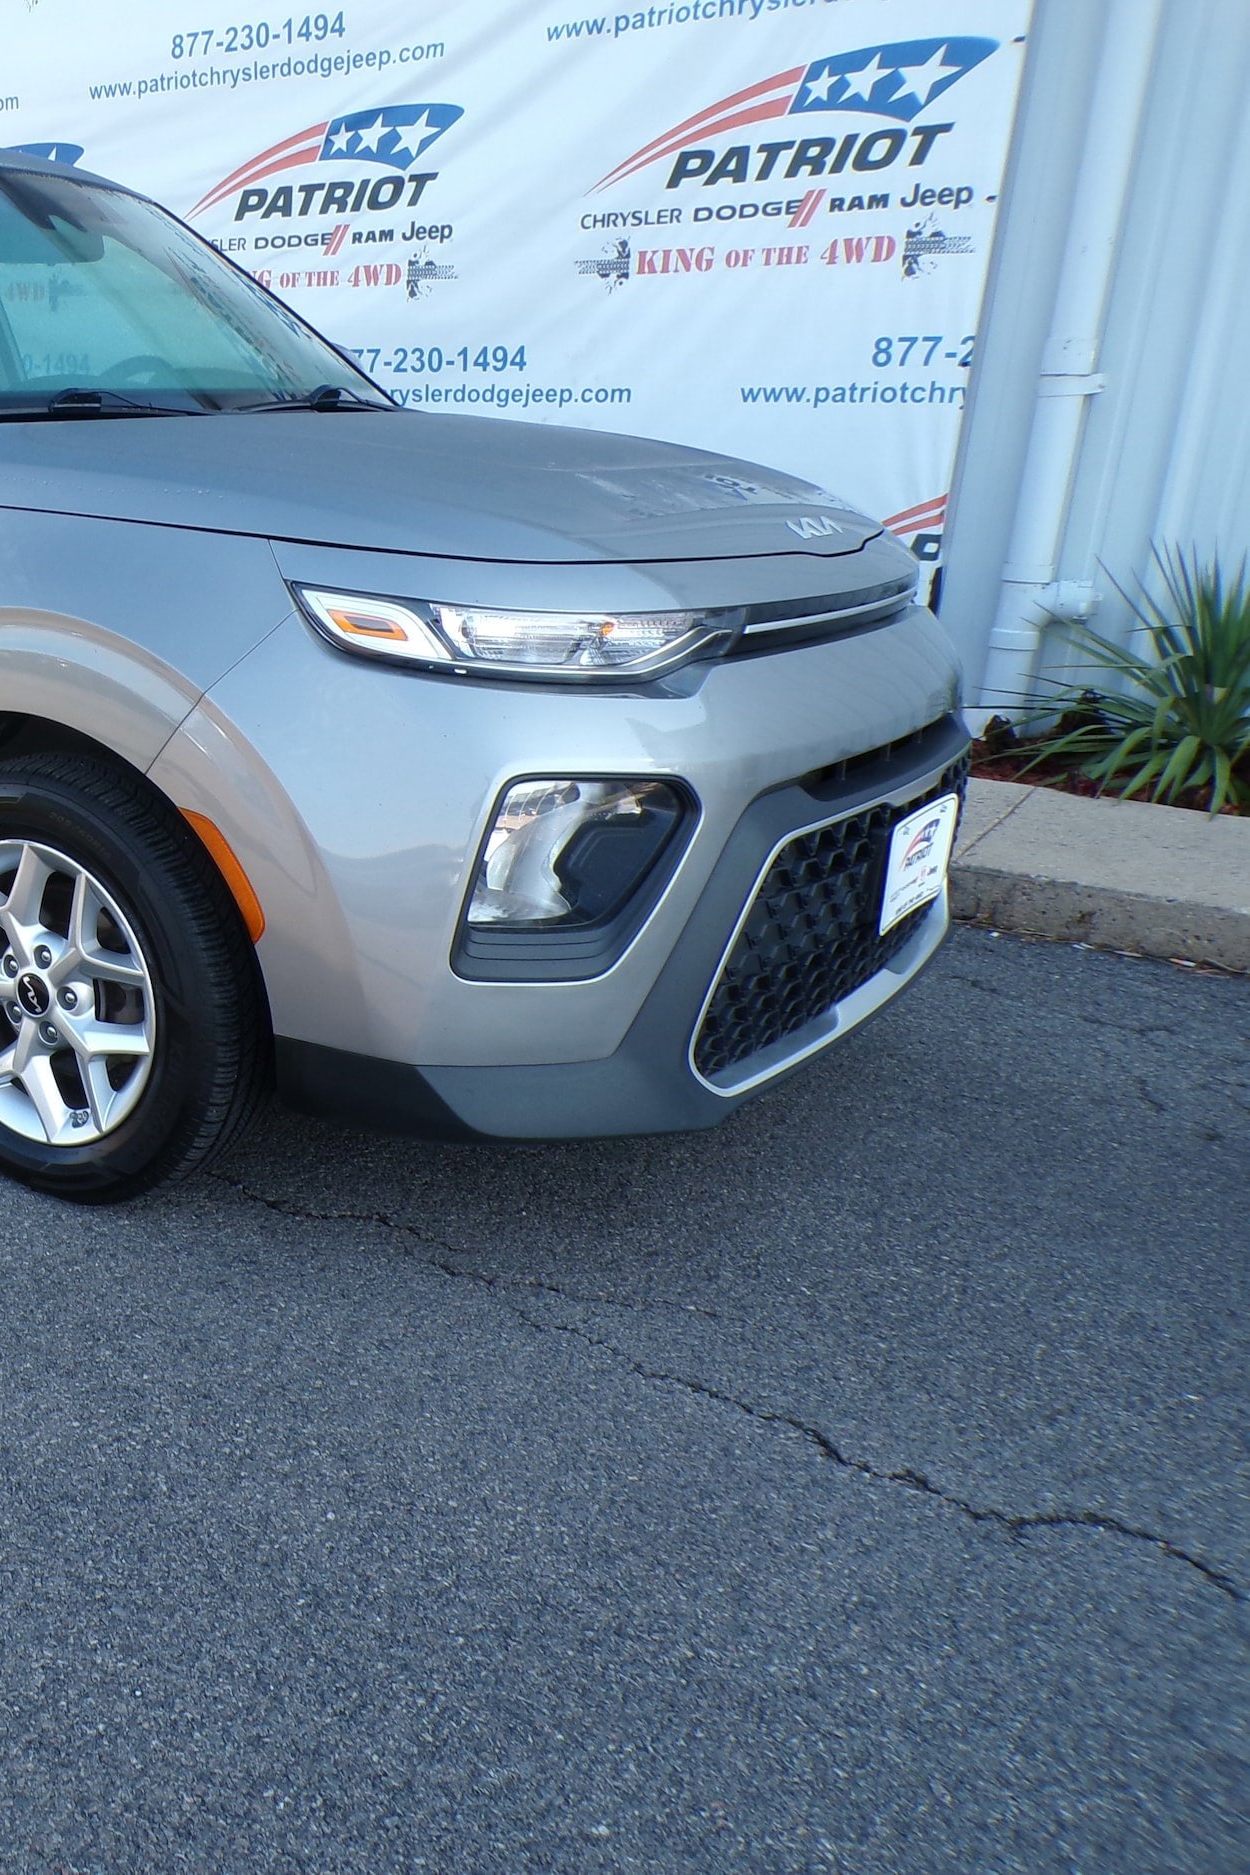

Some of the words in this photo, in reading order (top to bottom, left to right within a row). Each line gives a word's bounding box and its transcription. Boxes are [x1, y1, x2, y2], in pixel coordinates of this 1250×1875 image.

[170, 11, 346, 60] 877-230-1494
[89, 41, 445, 100] www.patriotchryslerdodgejeep.com
[665, 122, 956, 189] PATRIOT
[234, 172, 439, 221] PATRIOT
[580, 208, 683, 230] CHRYSLER
[693, 198, 804, 223] DODGE
[829, 193, 890, 213] RAM
[900, 184, 974, 210] Jeep
[254, 233, 333, 250] DODGE
[352, 229, 395, 245] RAM
[402, 221, 453, 244] Jeep
[635, 245, 715, 276] KING
[725, 249, 755, 269] OF
[761, 244, 810, 266] THE
[820, 235, 897, 265] 4WD
[280, 273, 299, 288] OF
[305, 270, 340, 287] THE
[347, 263, 403, 288] 4WD
